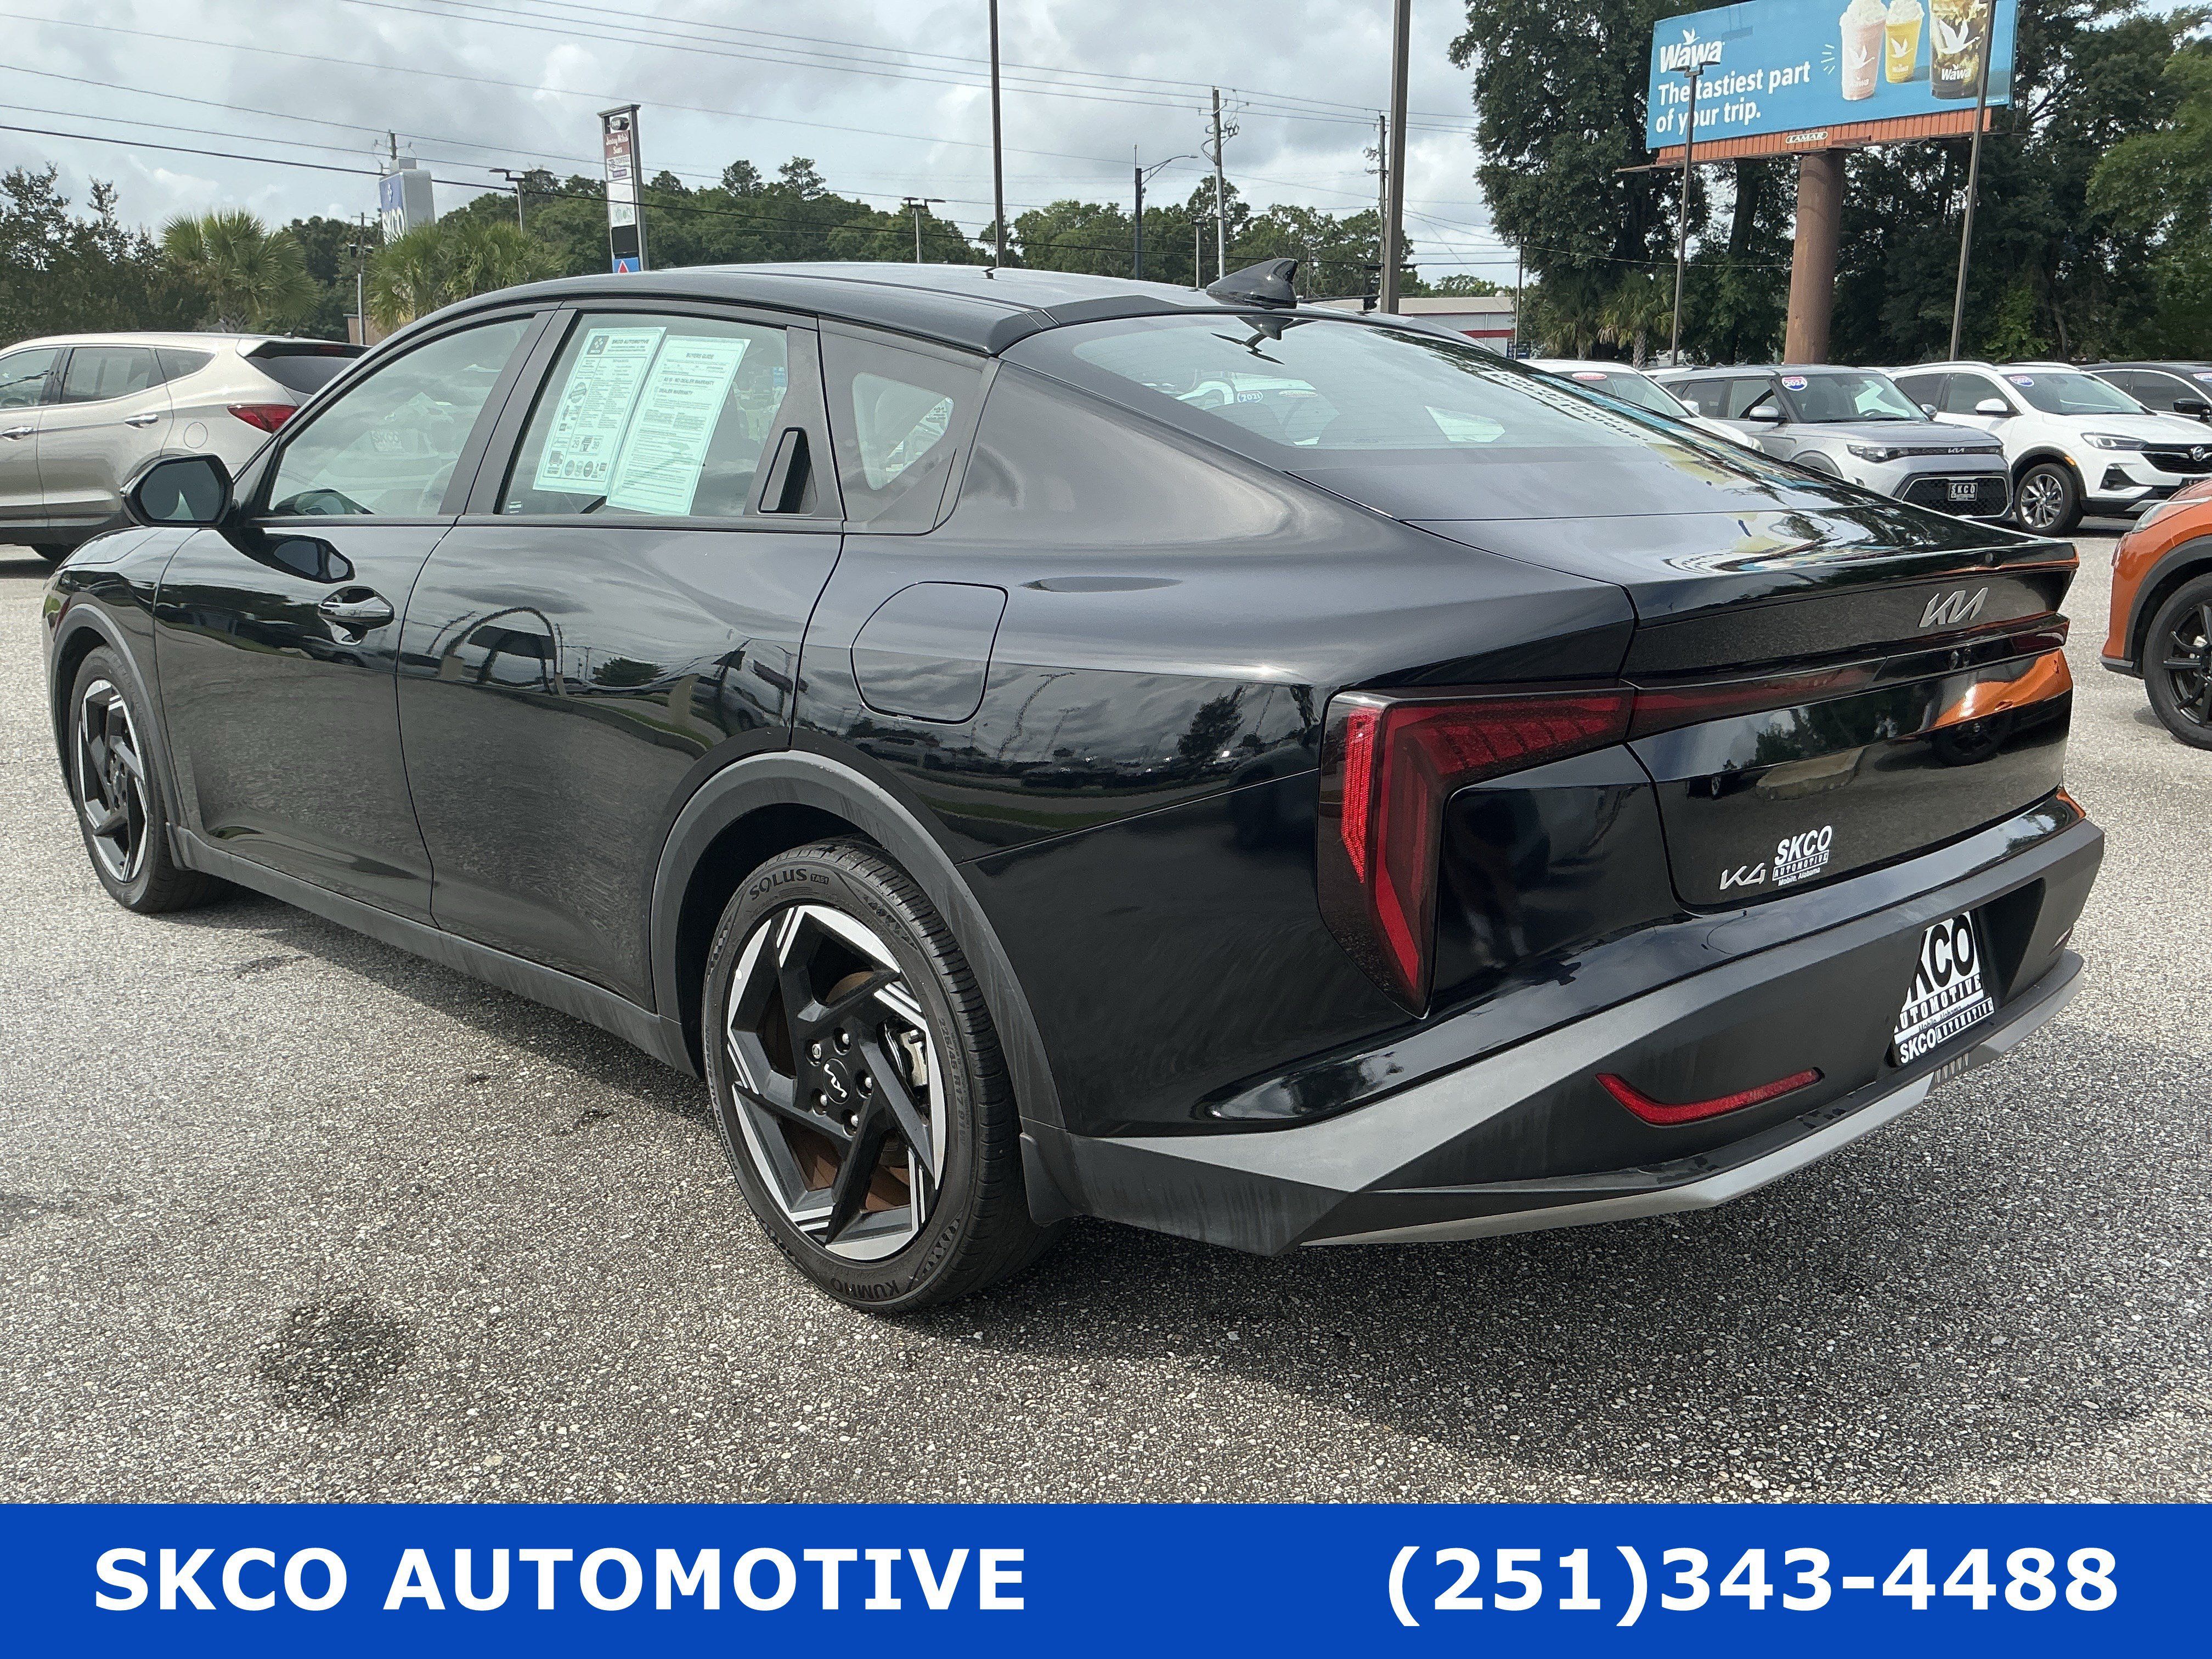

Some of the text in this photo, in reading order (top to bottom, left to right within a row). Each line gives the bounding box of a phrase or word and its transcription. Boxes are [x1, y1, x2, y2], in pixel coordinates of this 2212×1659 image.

[1660, 40, 1722, 73] Wawa
[1658, 61, 1810, 105] The tastiest part
[1942, 68, 1971, 81] Wawa
[1656, 97, 1761, 135] of your trip.
[1789, 133, 1824, 143] LAMAR
[1241, 388, 1261, 402] 2021
[1951, 483, 1976, 494] SKCO
[1919, 587, 1988, 628] KIA
[1774, 825, 1832, 866] SKCO
[1719, 862, 1766, 890] K4
[1774, 852, 1828, 878] AUTOMOTIVE
[749, 868, 808, 901] SOLUS
[1900, 1000, 1993, 1064] SKCO AUTOMOTIVE
[830, 1277, 900, 1300] KUMHO
